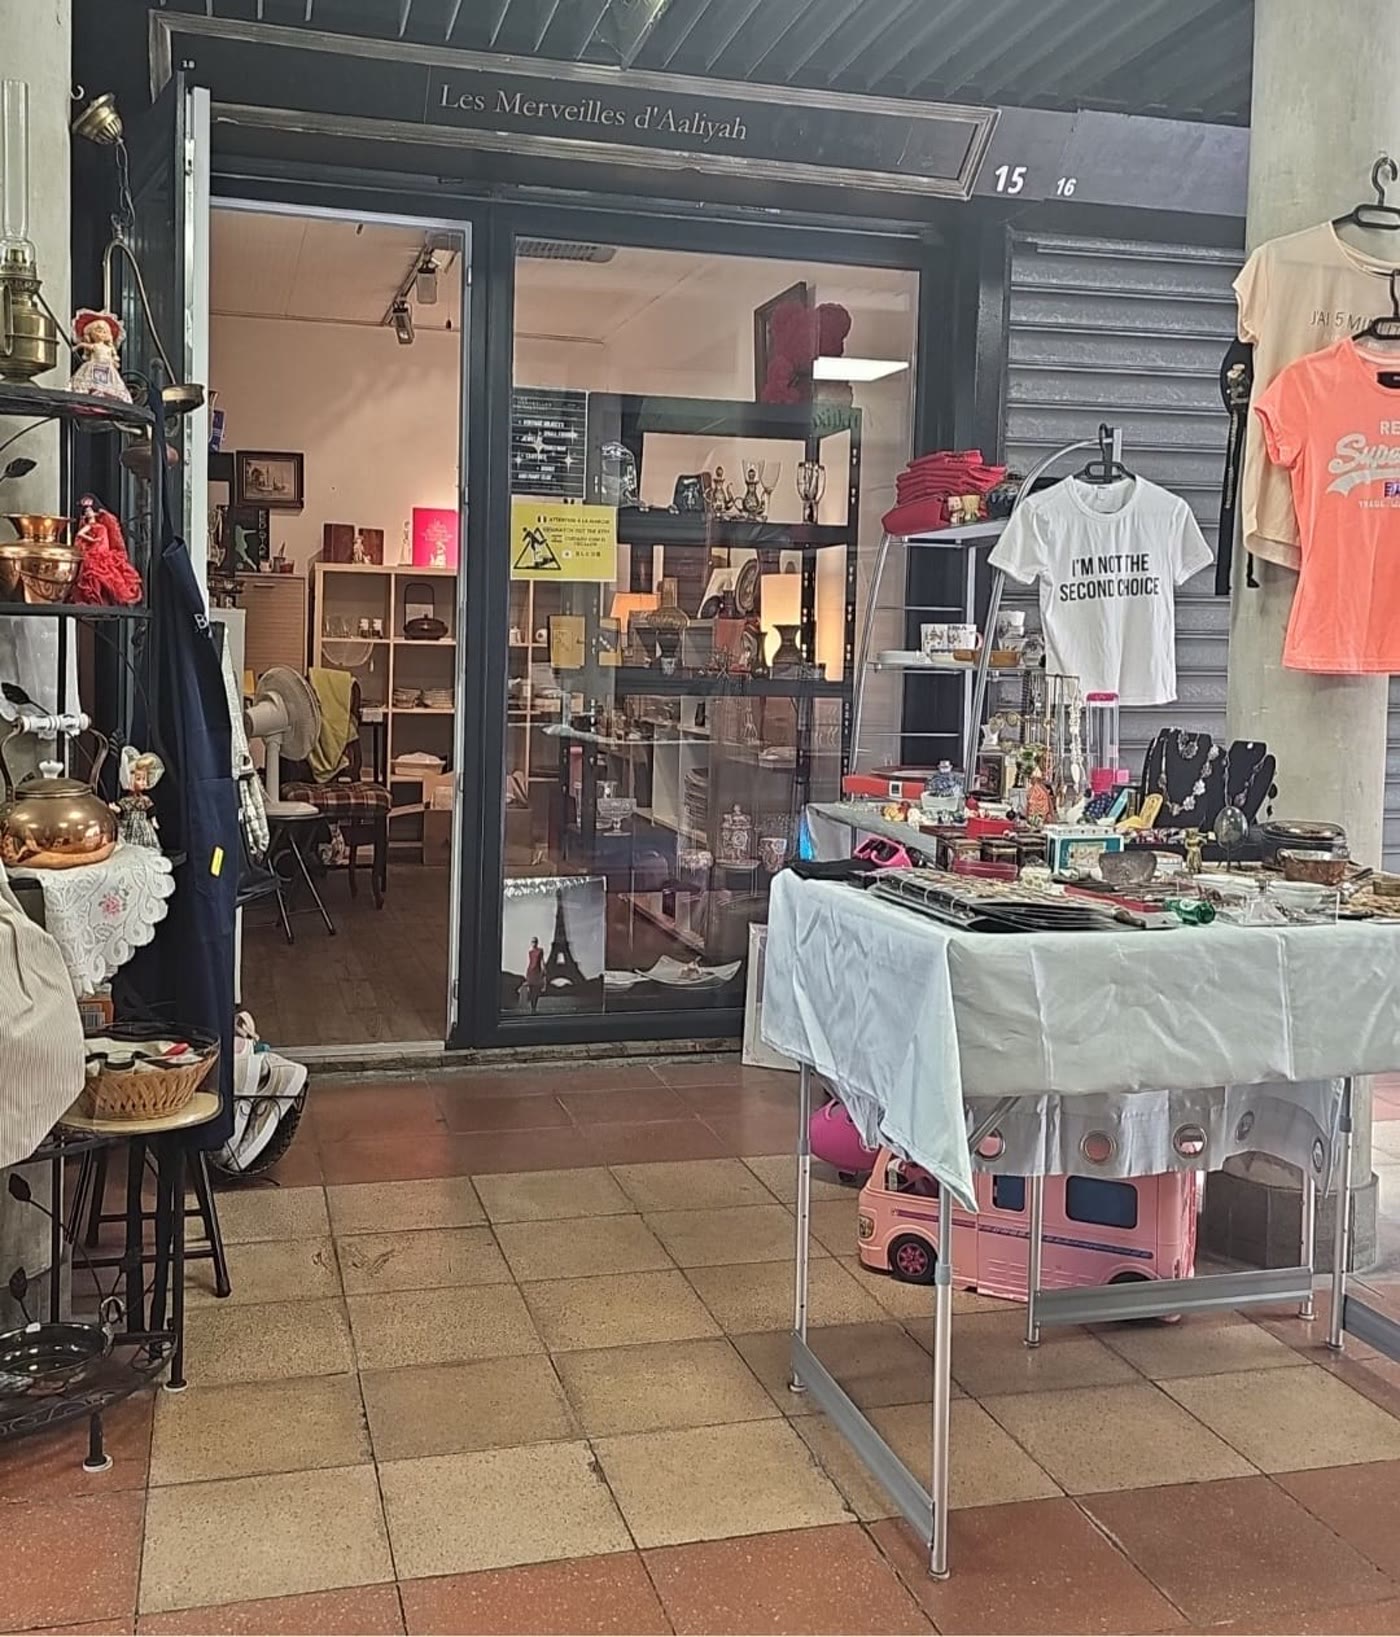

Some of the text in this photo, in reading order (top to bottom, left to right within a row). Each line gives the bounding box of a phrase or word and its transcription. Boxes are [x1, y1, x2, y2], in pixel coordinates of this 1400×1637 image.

[439, 84, 748, 143] Les Merveilles d'Aaliyah
[995, 165, 1028, 194] 15
[1057, 177, 1077, 197] 16
[1335, 311, 1345, 327] 5
[1072, 553, 1149, 577] I'M NOT THE
[1059, 577, 1160, 602] SECOND CHOICE
